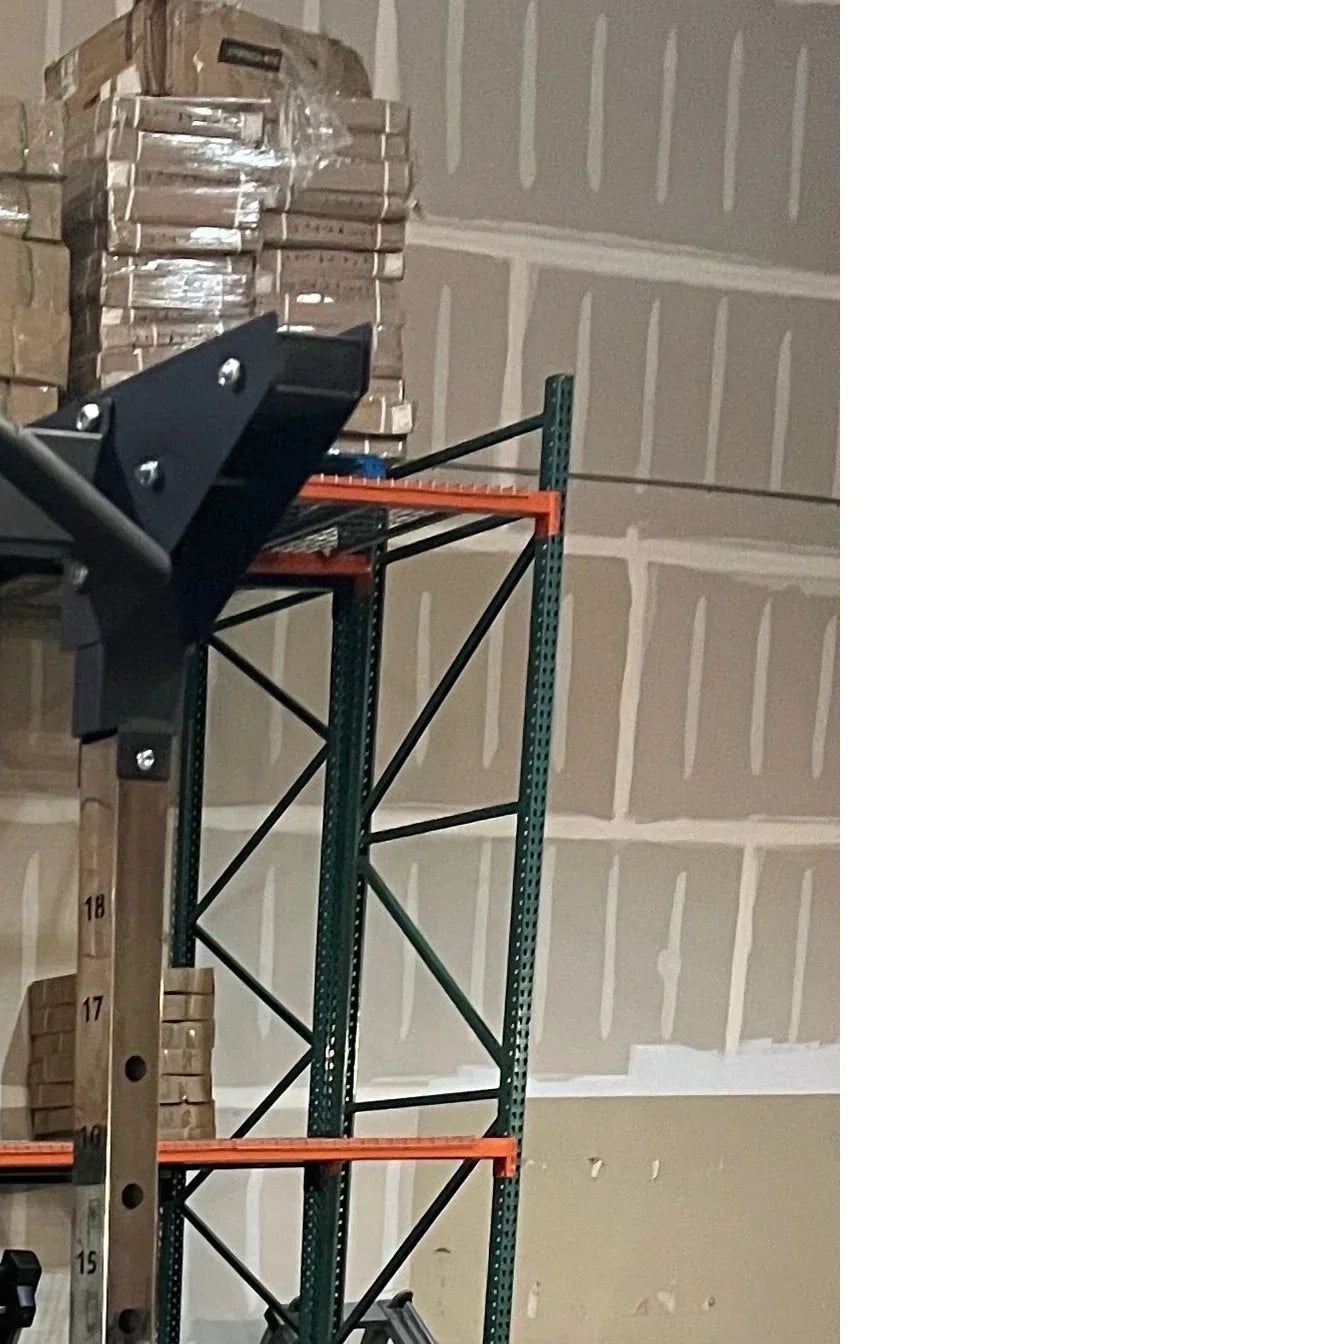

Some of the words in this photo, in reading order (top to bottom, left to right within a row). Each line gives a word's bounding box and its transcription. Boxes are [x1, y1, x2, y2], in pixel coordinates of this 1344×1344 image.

[84, 893, 106, 922] 18
[82, 995, 105, 1023] 17
[77, 1251, 97, 1276] 15
